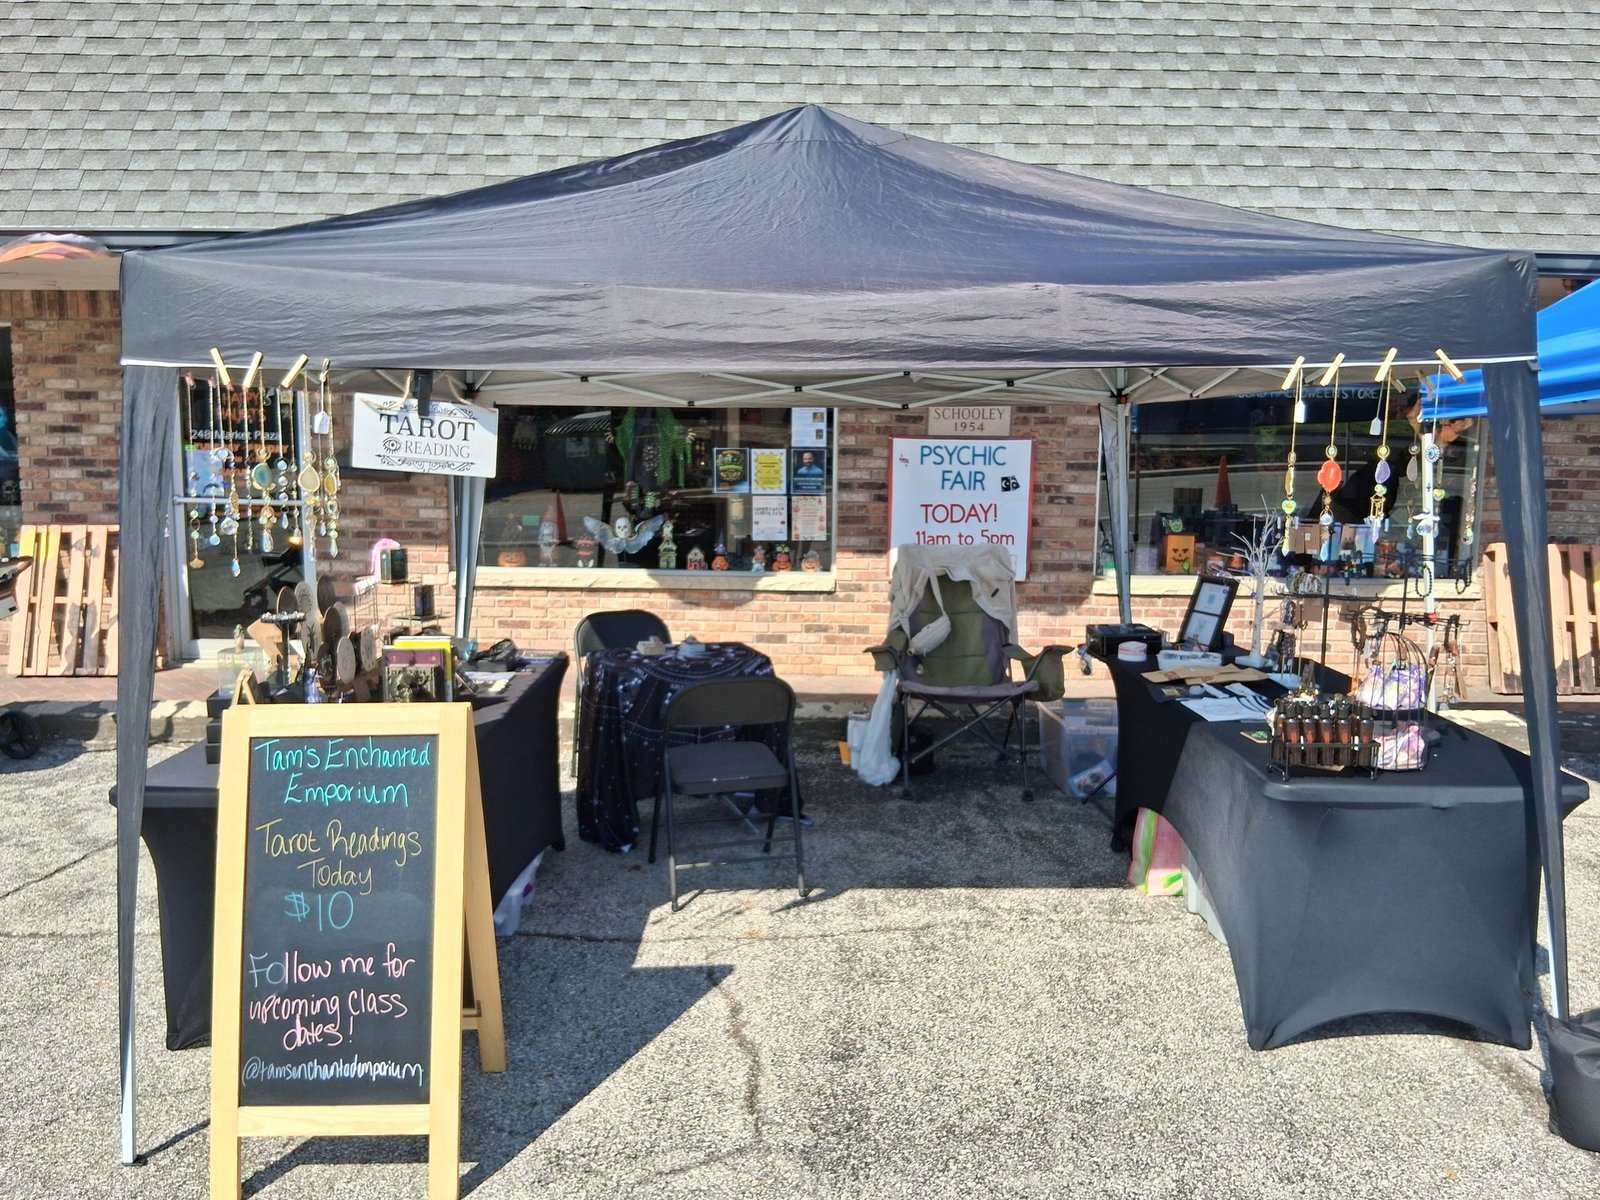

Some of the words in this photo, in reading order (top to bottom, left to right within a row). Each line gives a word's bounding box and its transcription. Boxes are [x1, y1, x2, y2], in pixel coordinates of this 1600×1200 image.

[1341, 386, 1379, 399] STORE
[933, 407, 1007, 420] SCHOOLEY
[379, 412, 476, 442] TAROT
[953, 421, 985, 432] 1954
[404, 440, 471, 459] READING
[920, 445, 1007, 466] PSYCHIC
[941, 470, 986, 491] FAIR
[920, 503, 998, 524] TODAY!
[915, 530, 951, 545] 11am
[957, 532, 975, 545] to
[254, 738, 321, 772] Tam's
[324, 736, 431, 772] Enchanted
[284, 773, 409, 808] Emporium
[256, 818, 321, 858] Tarot
[326, 819, 423, 867] Readings
[296, 857, 373, 896] Today
[284, 891, 355, 932] $10
[248, 951, 332, 989] Follow
[341, 956, 375, 976] me
[382, 942, 416, 979] for
[249, 993, 341, 1032] upcoming
